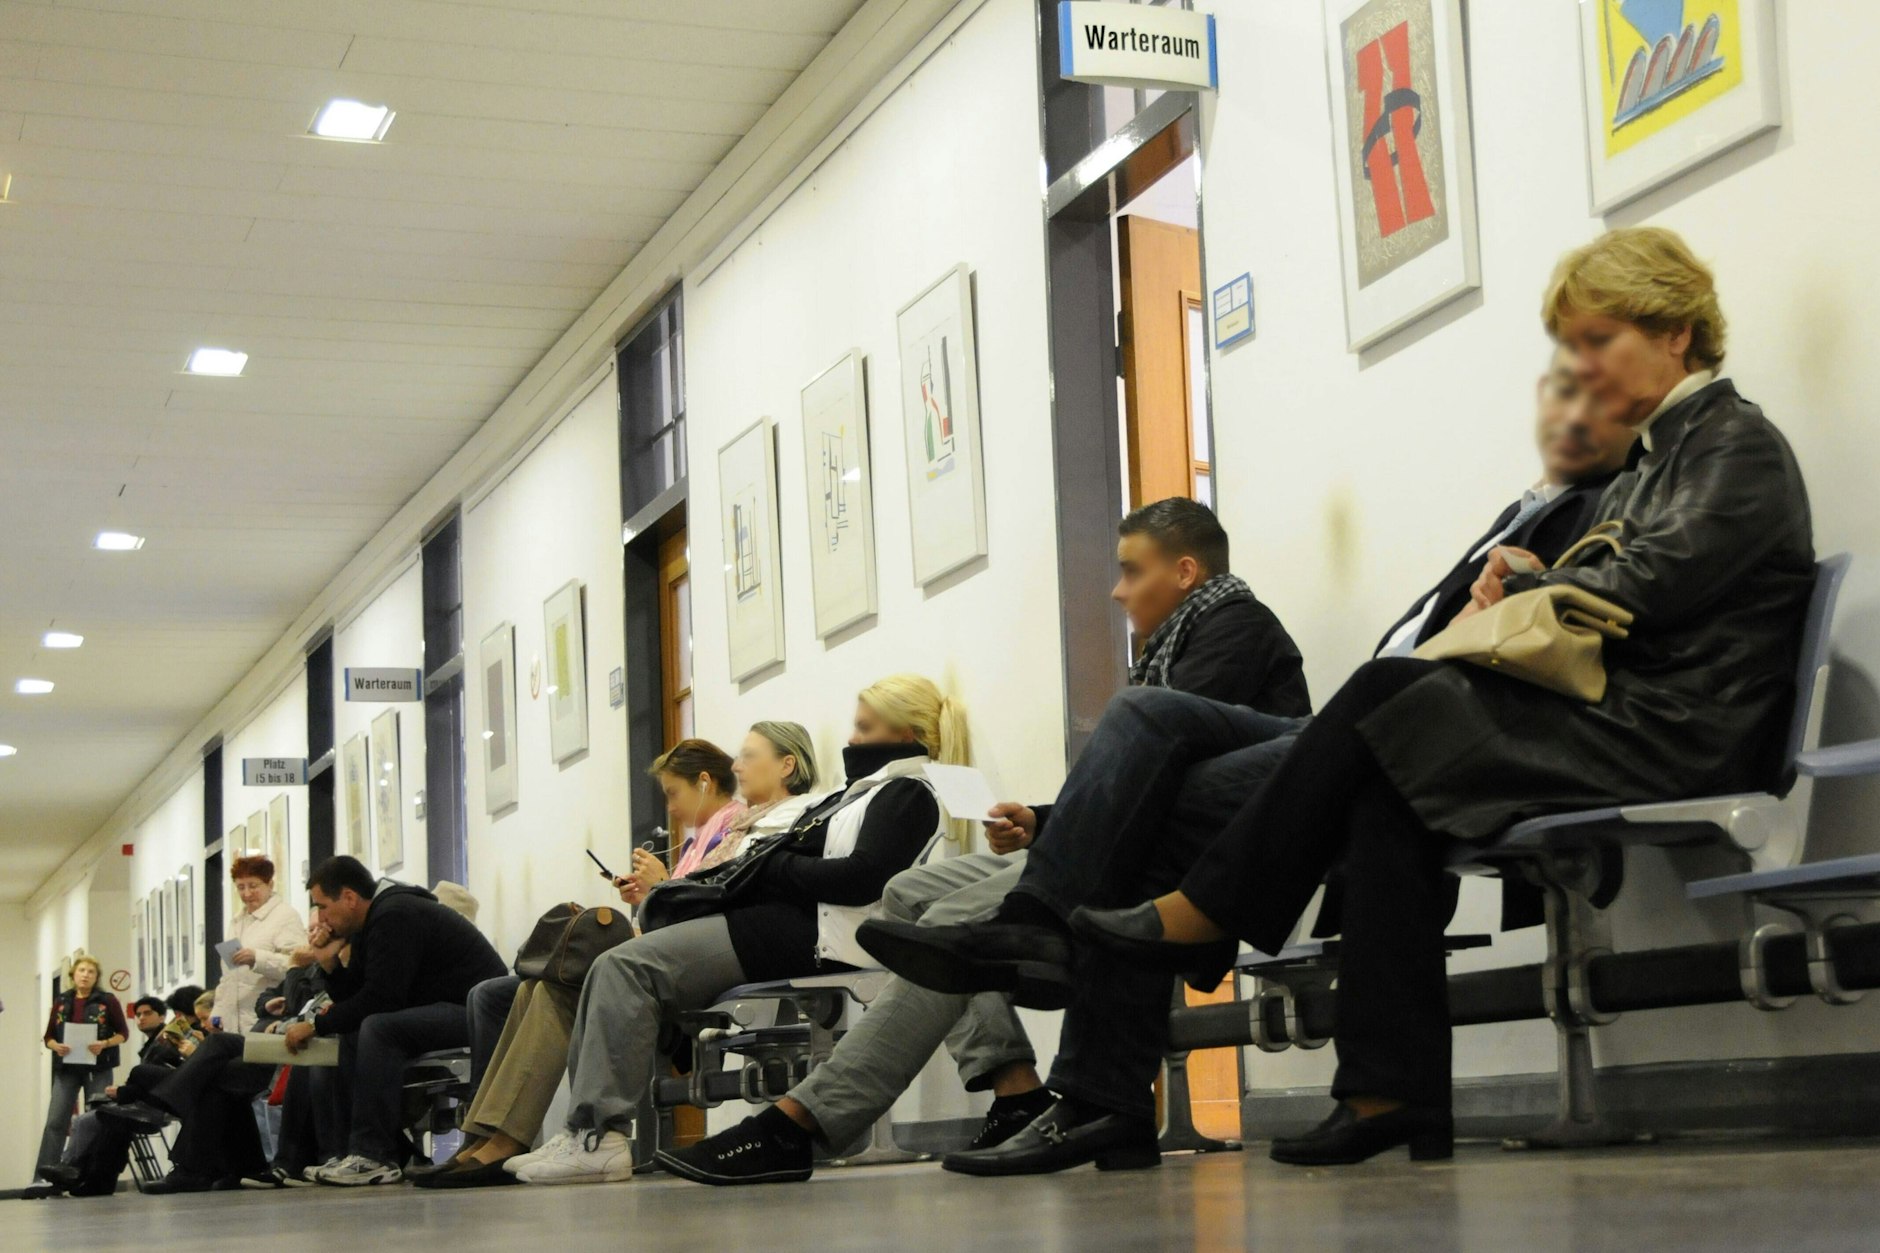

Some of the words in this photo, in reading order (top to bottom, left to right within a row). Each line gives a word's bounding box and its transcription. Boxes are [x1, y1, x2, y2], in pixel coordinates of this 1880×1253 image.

[1085, 24, 1200, 59] Warteraum
[354, 677, 412, 690] Warteraum
[263, 759, 286, 769] Platz
[255, 773, 265, 783] 15
[268, 773, 281, 783] bis
[284, 773, 295, 783] 18
